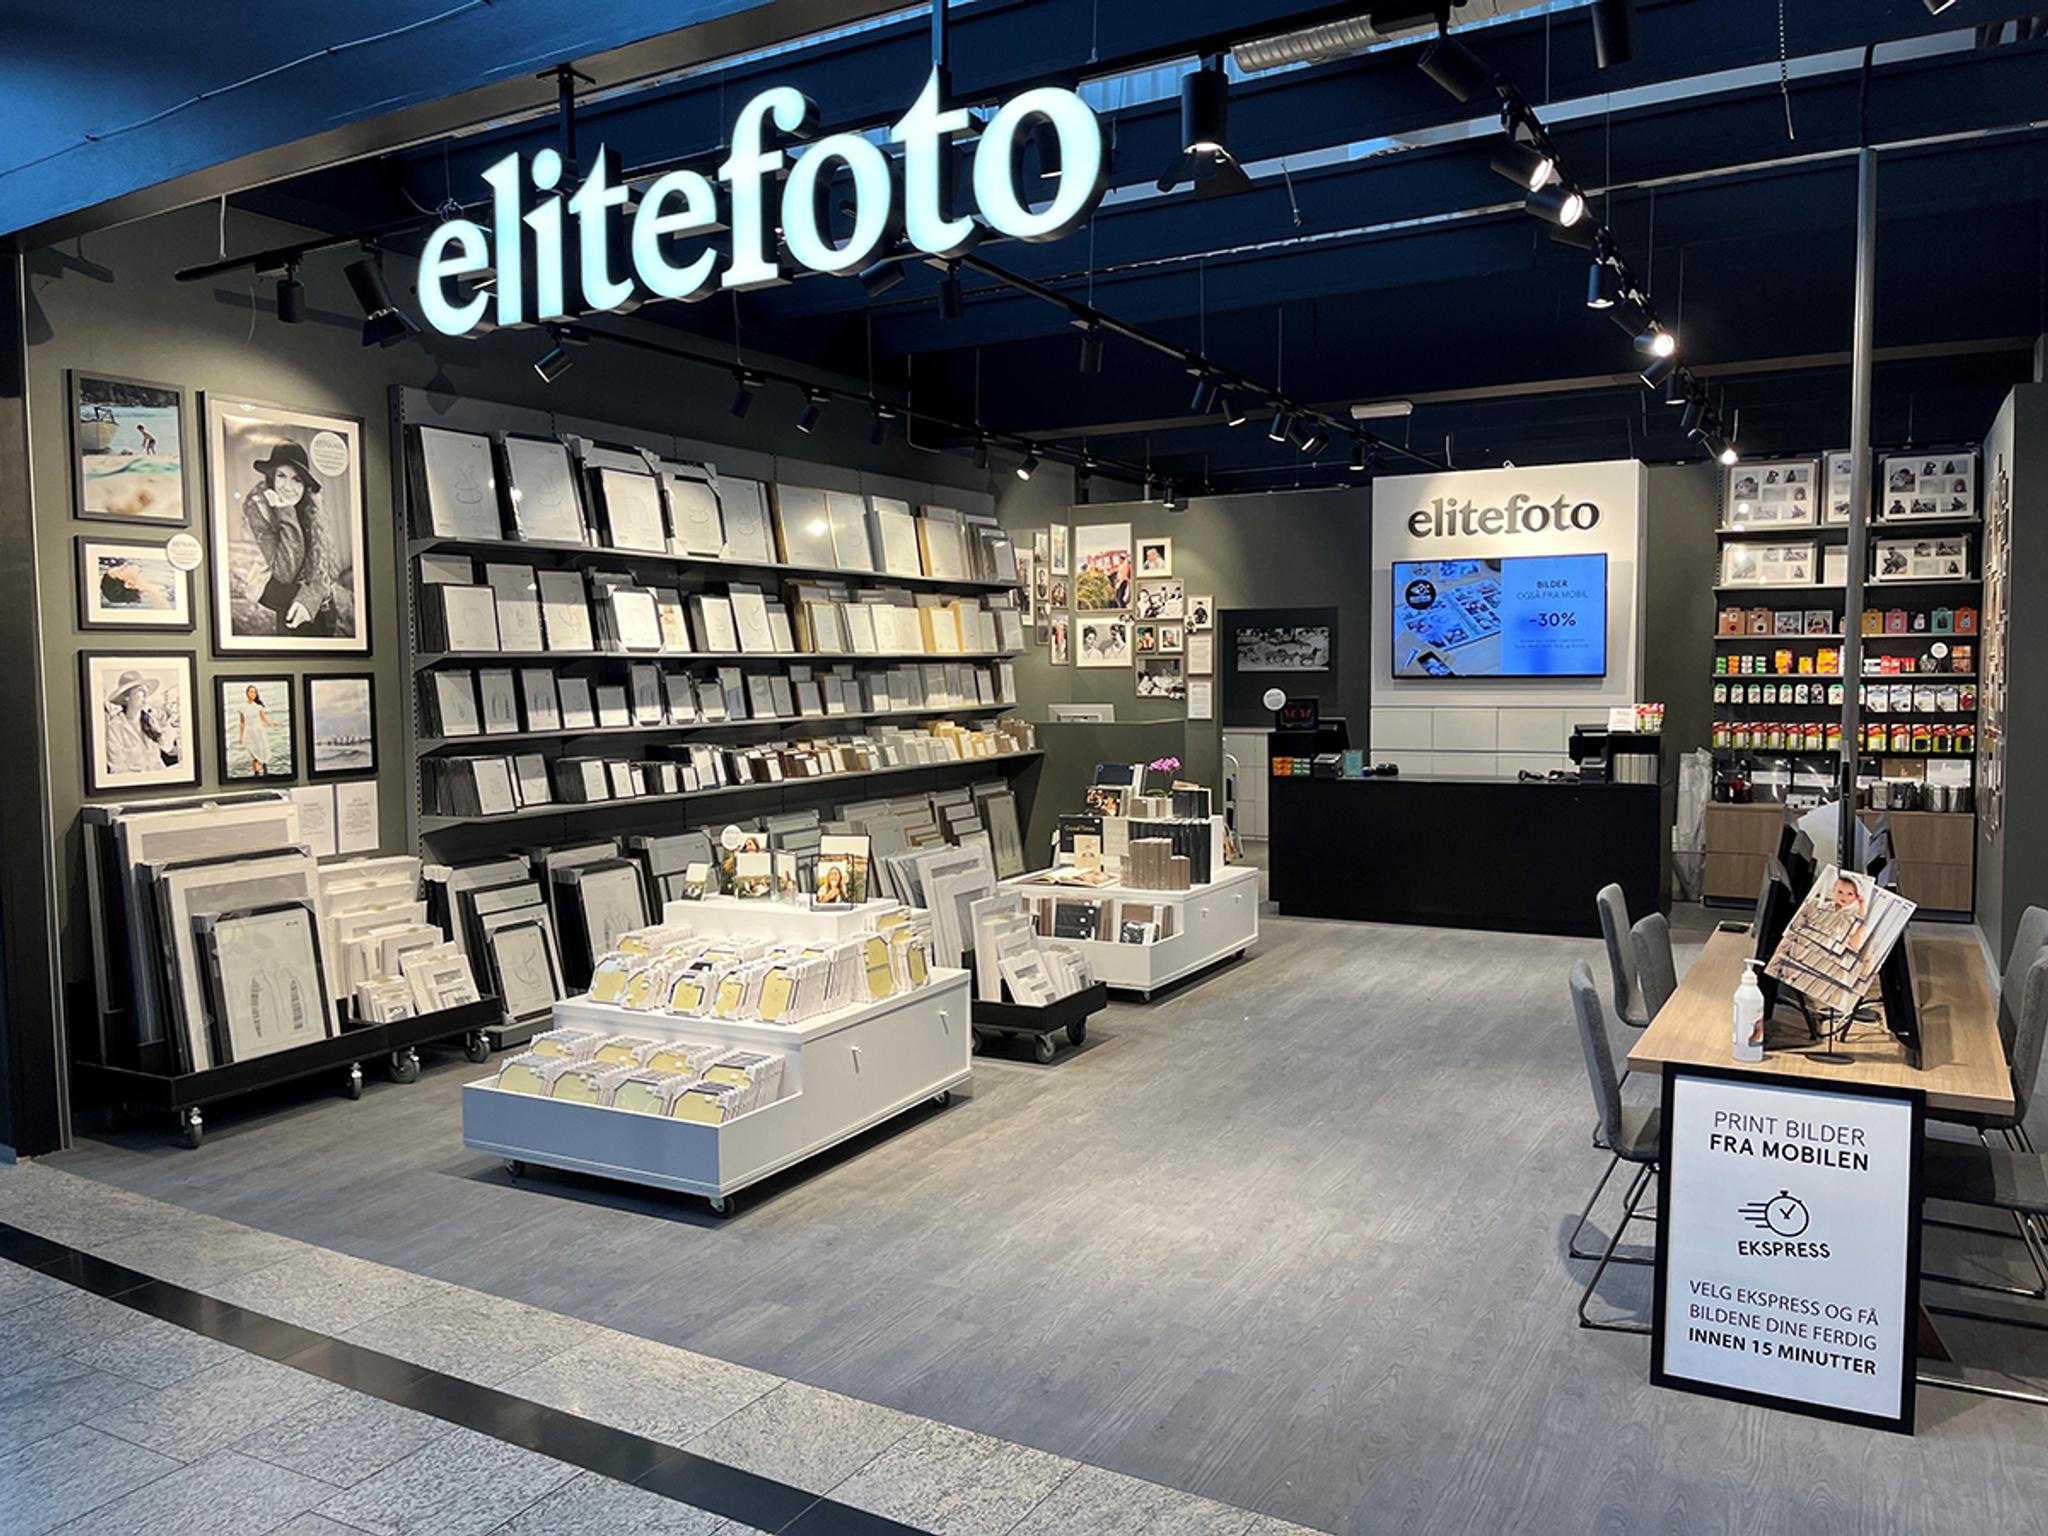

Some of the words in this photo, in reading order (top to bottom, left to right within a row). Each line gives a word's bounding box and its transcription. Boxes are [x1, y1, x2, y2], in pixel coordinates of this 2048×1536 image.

[418, 63, 1100, 336] elitefoto
[1408, 493, 1600, 538] elitefoto
[1516, 590, 1541, 600] OGSÅ
[1542, 590, 1559, 599] FRA
[1561, 589, 1588, 599] MOBIL
[1537, 580, 1568, 589] BILDER
[1529, 611, 1576, 627] -30%
[1714, 1111, 1779, 1135] PRINT
[1785, 1119, 1865, 1147] BILDER
[1710, 1133, 1755, 1156] FRA
[1762, 1140, 1869, 1171] MOBILEN
[1737, 1240, 1831, 1258] EKSPRESS
[1690, 1279, 1732, 1301] VELG
[1737, 1288, 1821, 1316] EKSPRESS
[1825, 1303, 1852, 1322] OG
[1858, 1307, 1879, 1327] FÅ
[1690, 1304, 1761, 1330] BILDENE
[1765, 1317, 1808, 1338] DINE
[1812, 1325, 1877, 1350] FERDIG
[1689, 1327, 1746, 1351] INNEN
[1751, 1339, 1773, 1357] 15
[1777, 1344, 1877, 1375] MINUTTER
